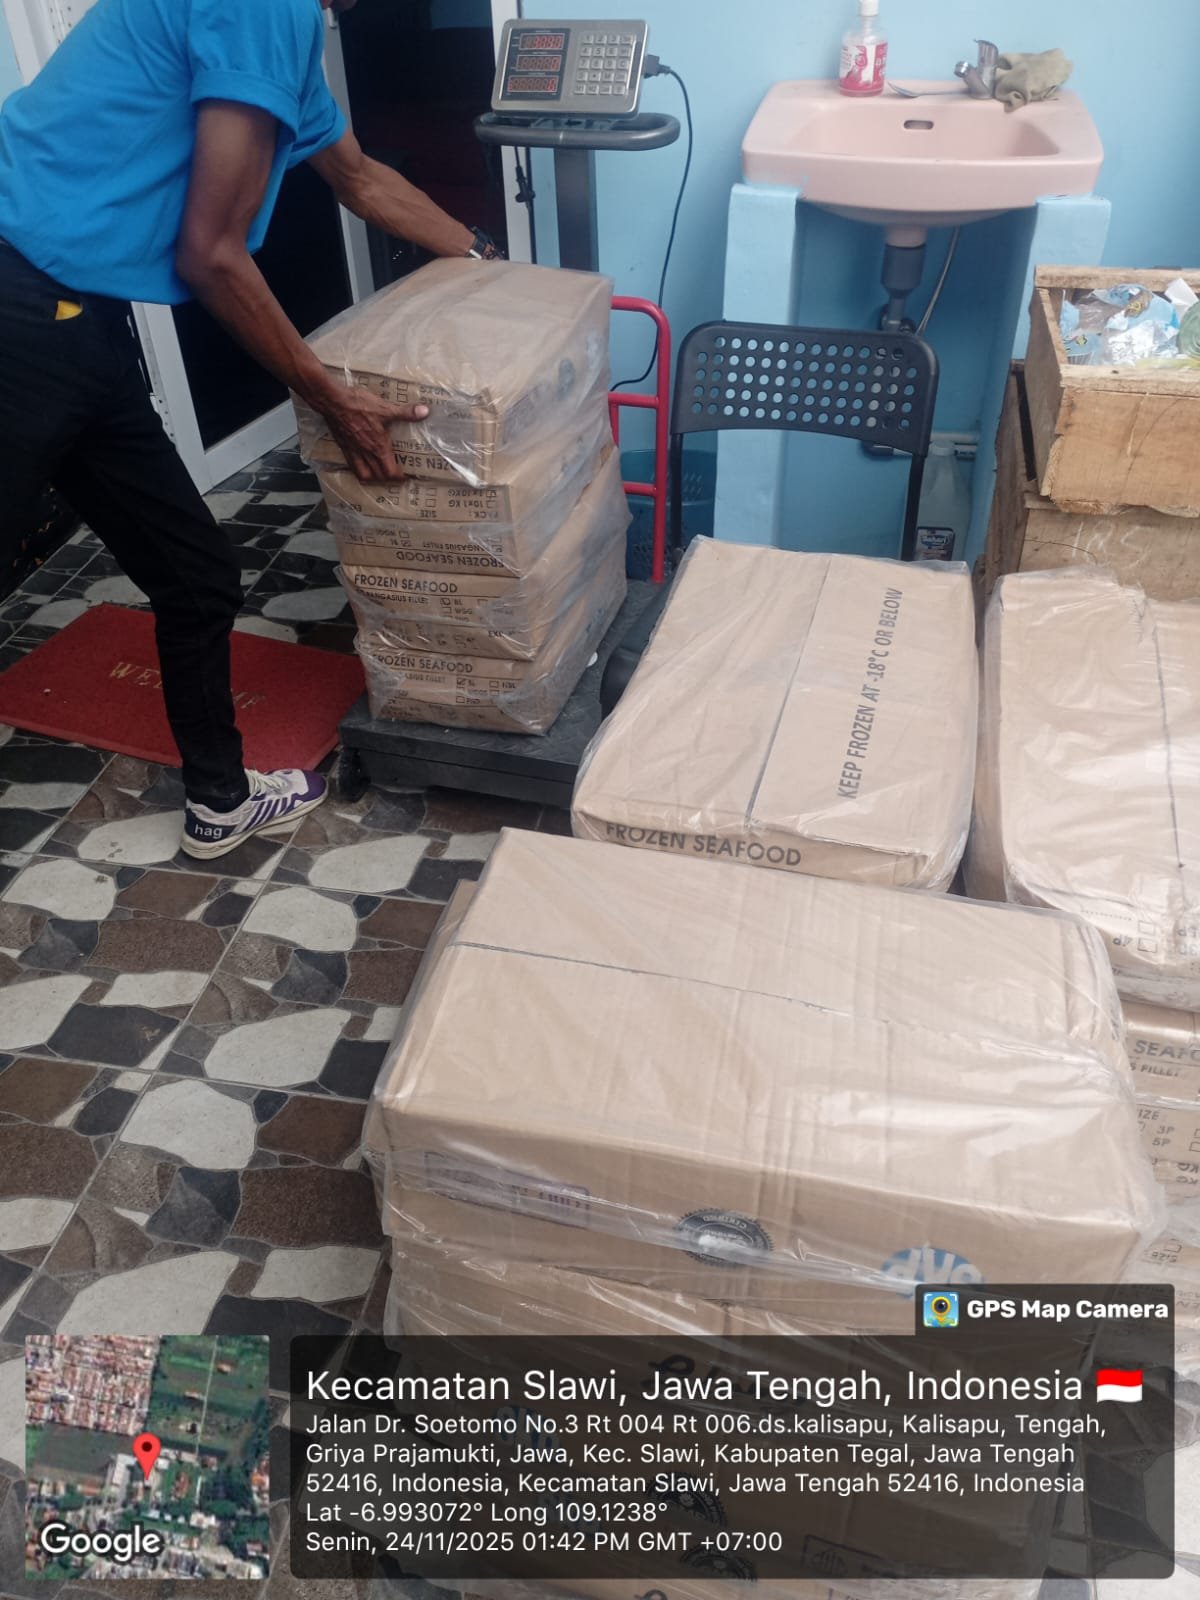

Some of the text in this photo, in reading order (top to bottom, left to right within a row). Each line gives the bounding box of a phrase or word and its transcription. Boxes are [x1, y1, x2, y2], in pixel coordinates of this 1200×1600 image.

[395, 550, 455, 564] SEAFOOD
[354, 574, 458, 594] FROZEN SEAFOOD
[878, 587, 904, 628] BELOW
[874, 629, 894, 647] OR
[419, 657, 473, 673] SEAFOOD
[860, 683, 881, 703] AT
[847, 704, 876, 759] FROZEN
[837, 761, 863, 800] KEEP
[194, 823, 223, 840] hag
[606, 822, 801, 867] FROZEN SEAFOOD
[1137, 1109, 1161, 1121] IZE
